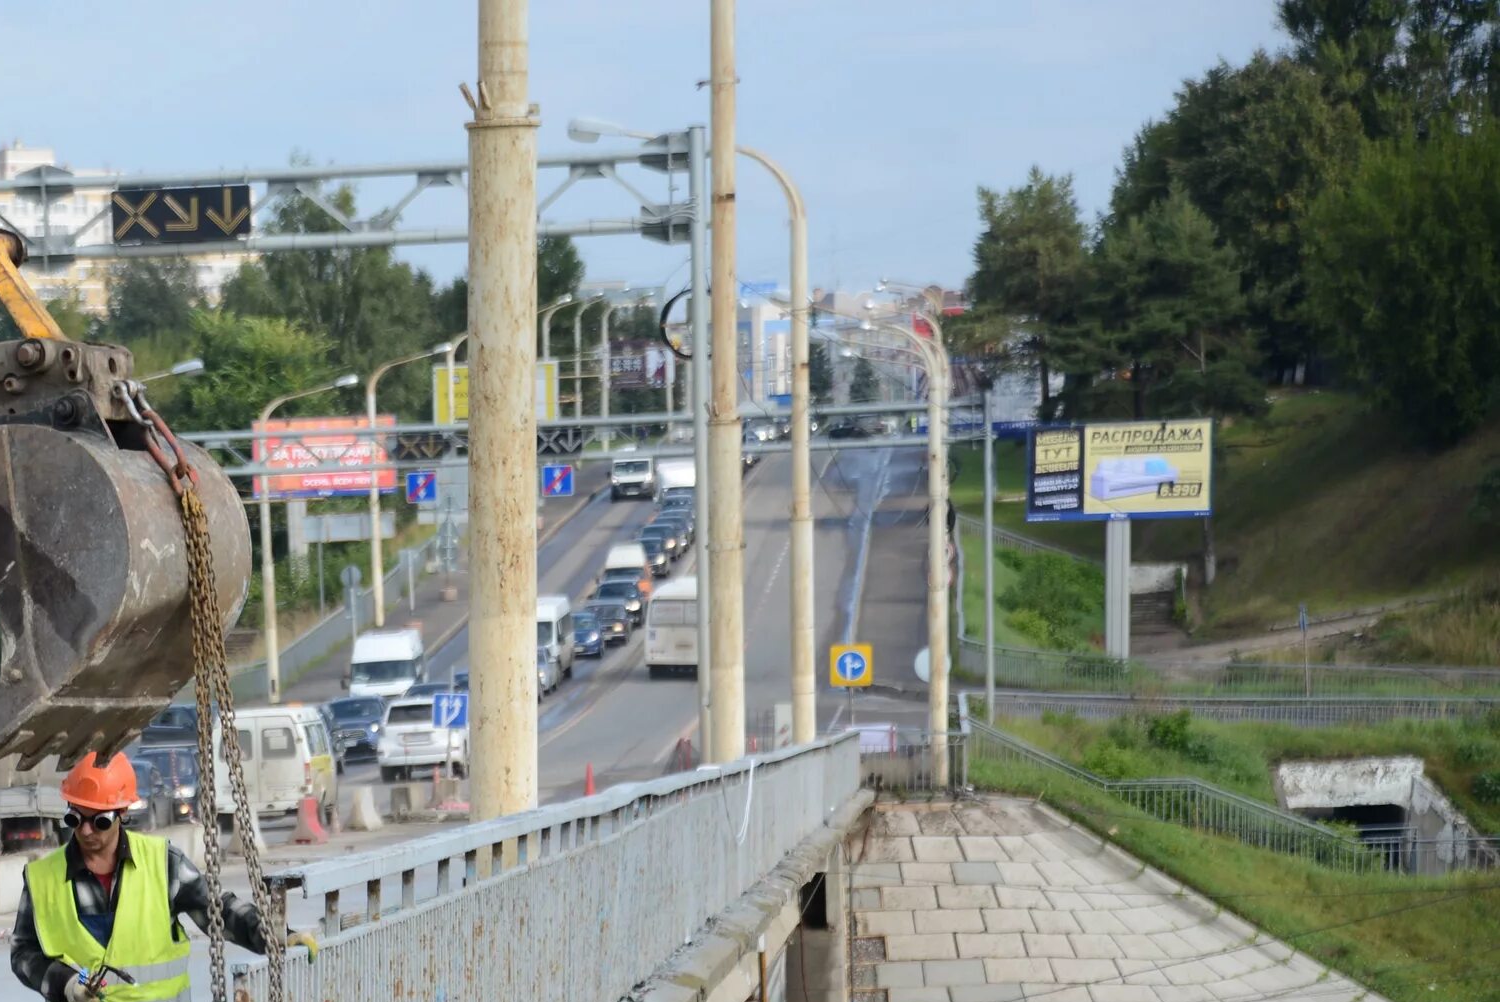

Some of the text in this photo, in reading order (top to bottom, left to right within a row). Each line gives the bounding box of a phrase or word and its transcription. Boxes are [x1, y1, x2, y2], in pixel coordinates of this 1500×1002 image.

[1090, 428, 1203, 444] РАСПРОДАЖА
[1041, 446, 1073, 460] ТУТ
[1160, 484, 1198, 497] 6.990
